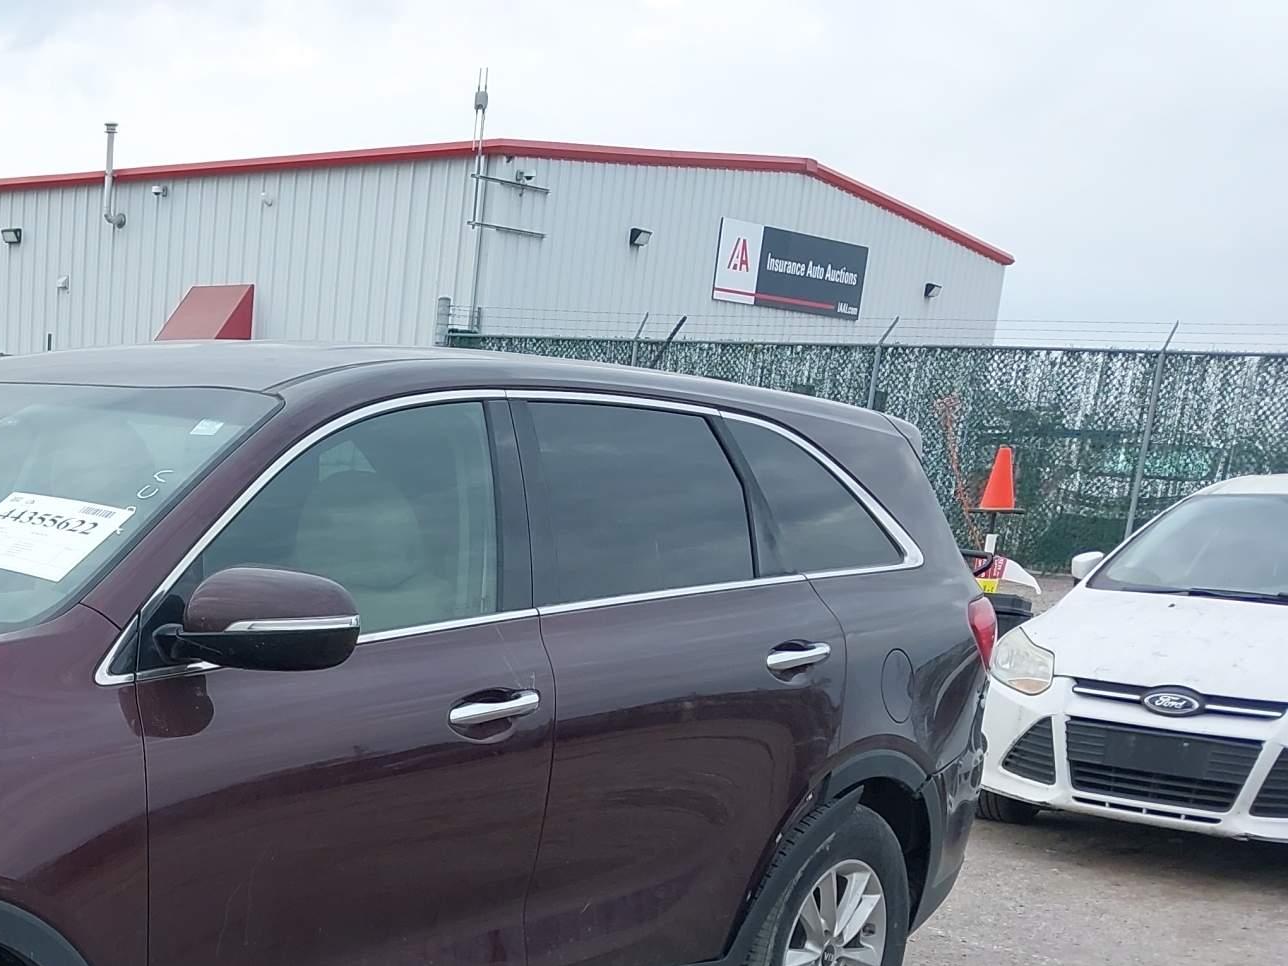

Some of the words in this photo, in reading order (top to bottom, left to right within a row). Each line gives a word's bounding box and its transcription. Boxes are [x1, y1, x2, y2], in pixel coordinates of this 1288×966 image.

[767, 252, 805, 277] Insurance
[806, 260, 825, 280] Auto
[825, 263, 858, 286] Auctions
[0, 508, 98, 535] 44355622
[1154, 695, 1187, 709] Ford
